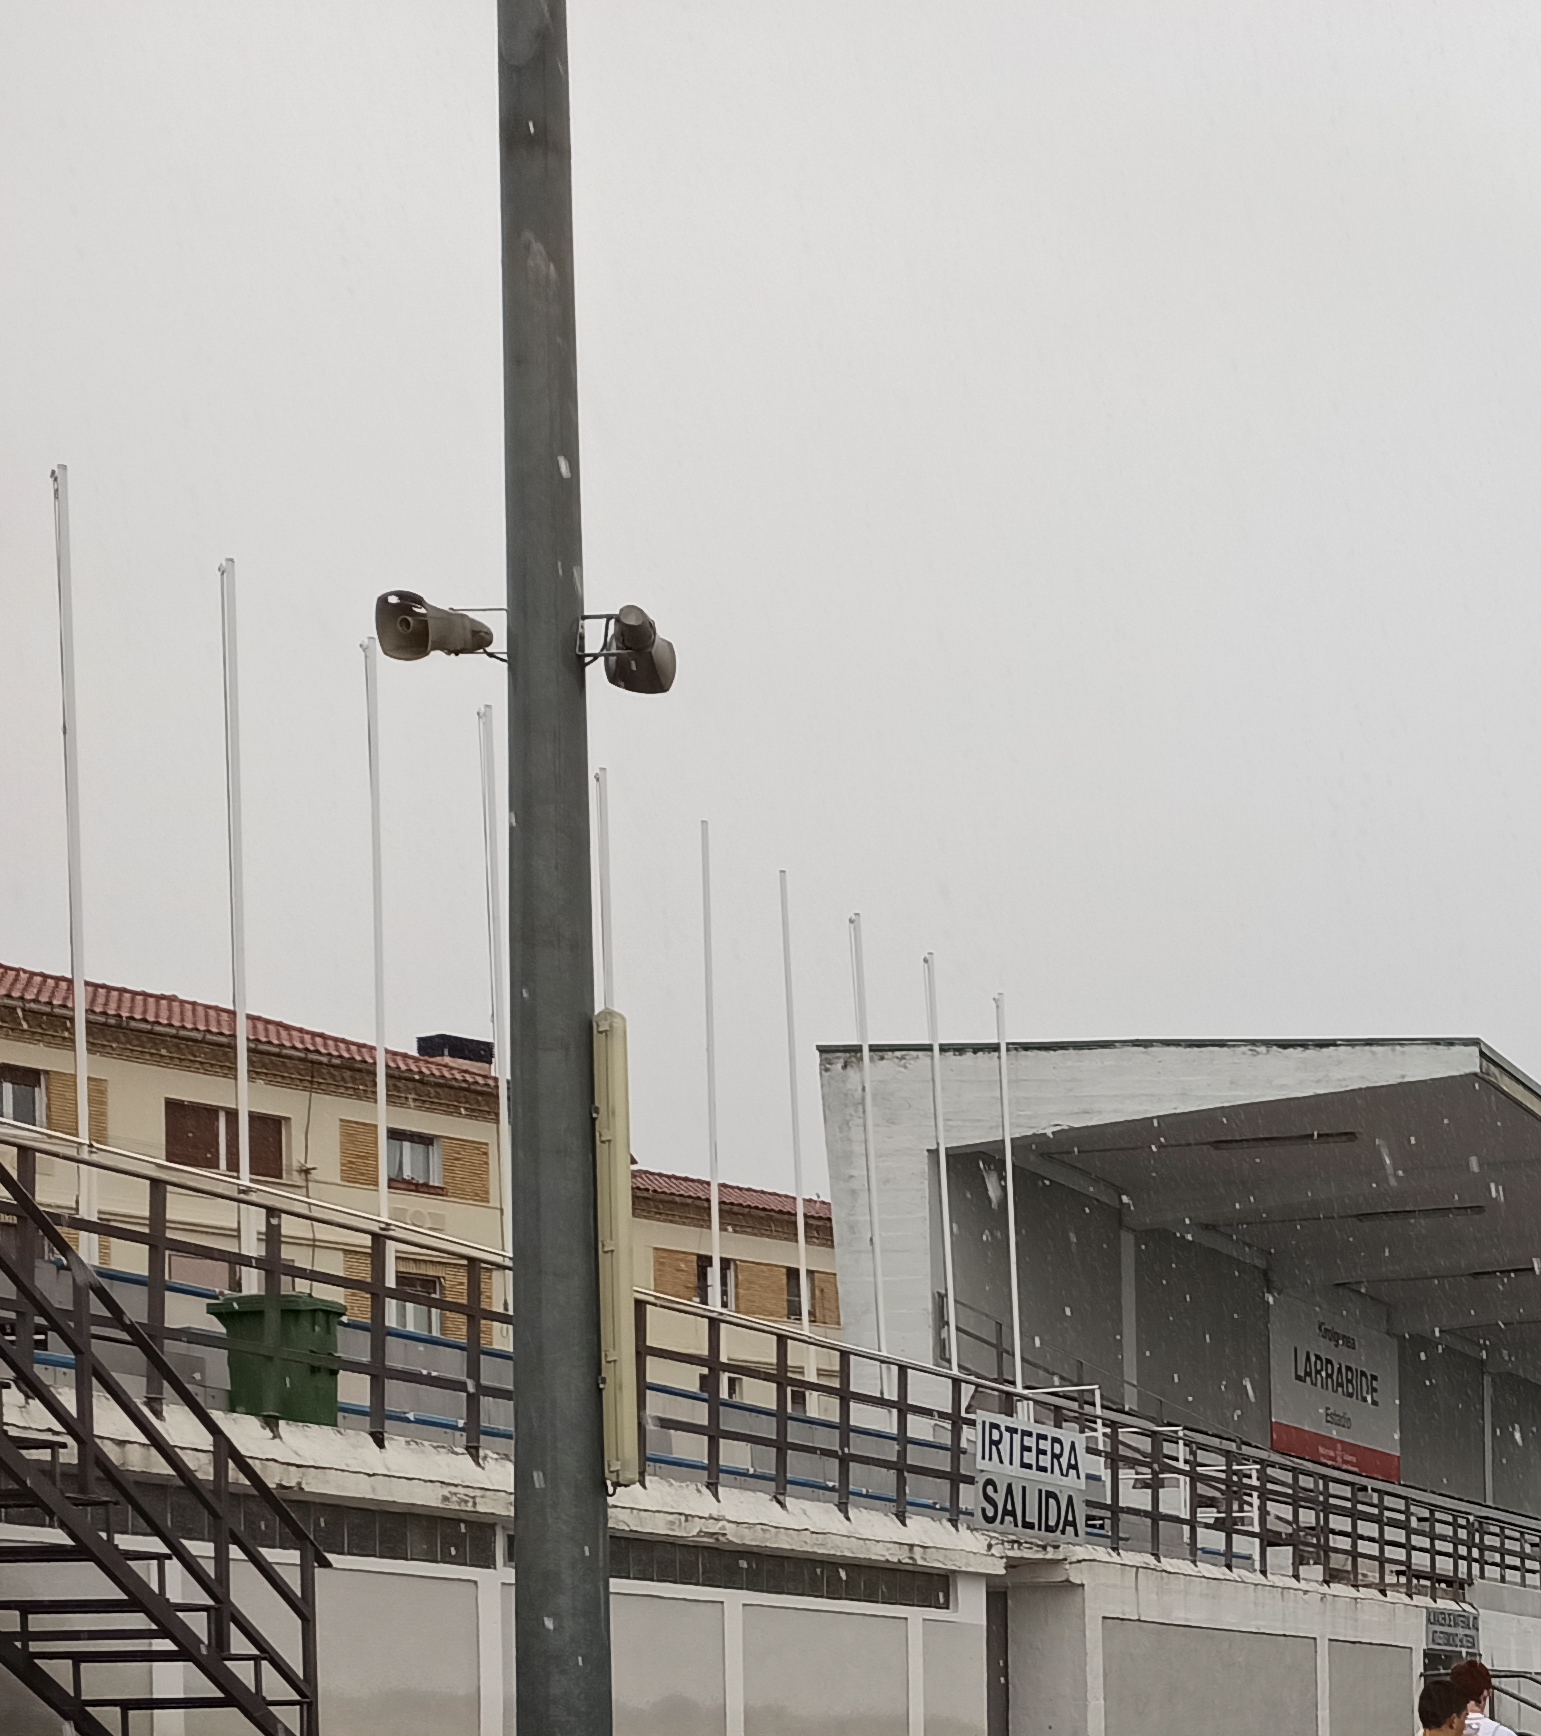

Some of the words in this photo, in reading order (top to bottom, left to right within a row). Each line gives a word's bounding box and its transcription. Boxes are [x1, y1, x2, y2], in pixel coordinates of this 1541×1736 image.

[1294, 1346, 1379, 1407] LARRABIDE
[981, 1420, 1081, 1480] IRTEERA
[980, 1478, 1079, 1538] SALIDA
